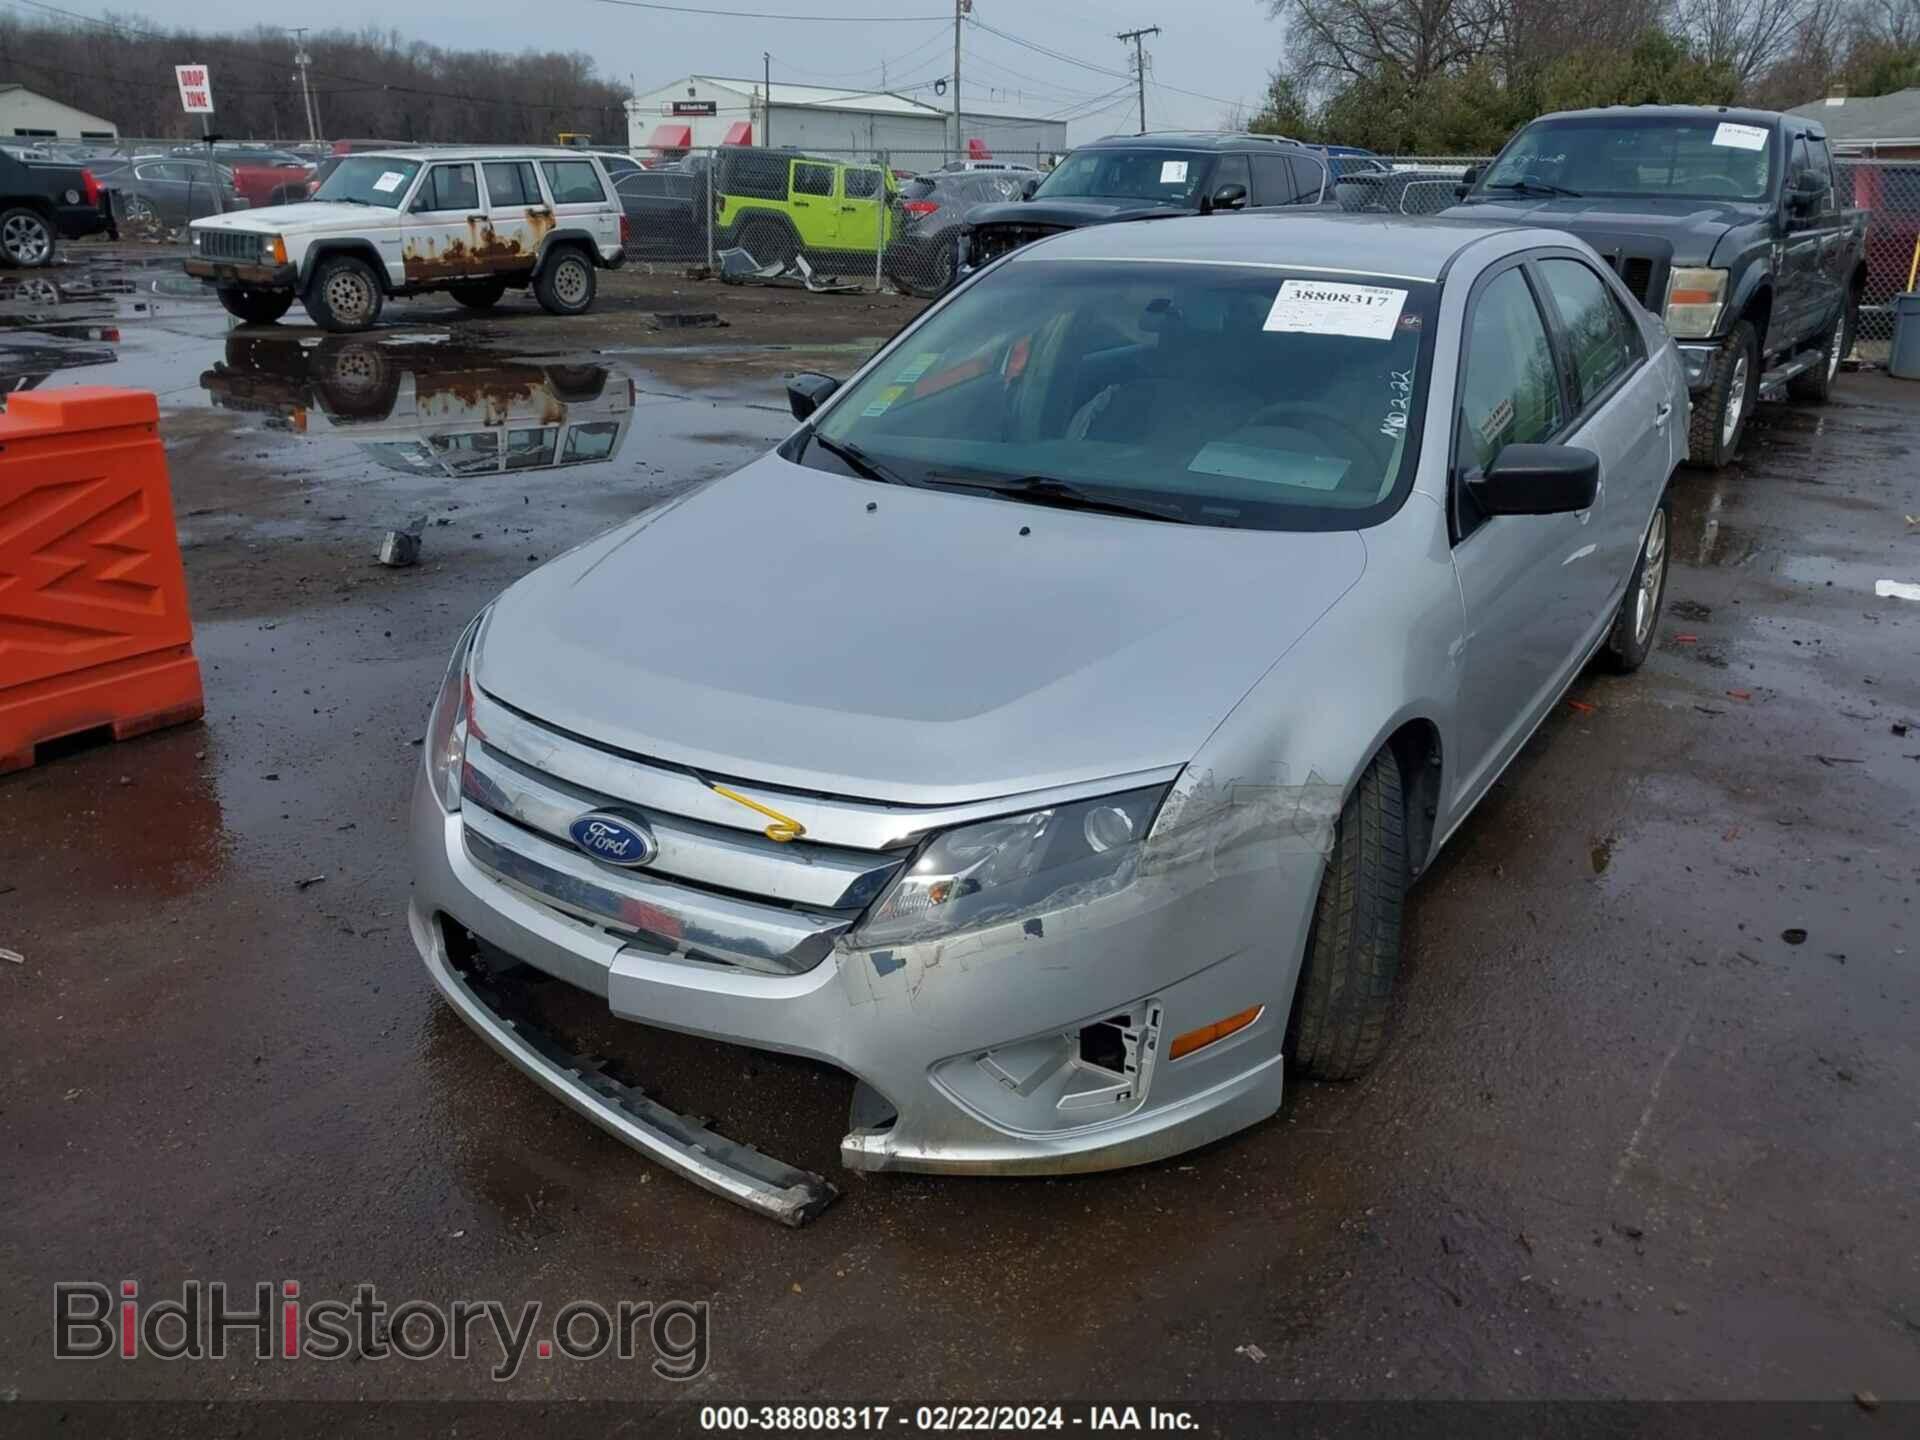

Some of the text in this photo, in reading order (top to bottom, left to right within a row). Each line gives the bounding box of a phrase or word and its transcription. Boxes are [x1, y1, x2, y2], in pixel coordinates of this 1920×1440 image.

[181, 70, 204, 86] DROP
[186, 92, 207, 107] ZONE
[1293, 289, 1389, 307] 38808317
[583, 822, 630, 856] Ford
